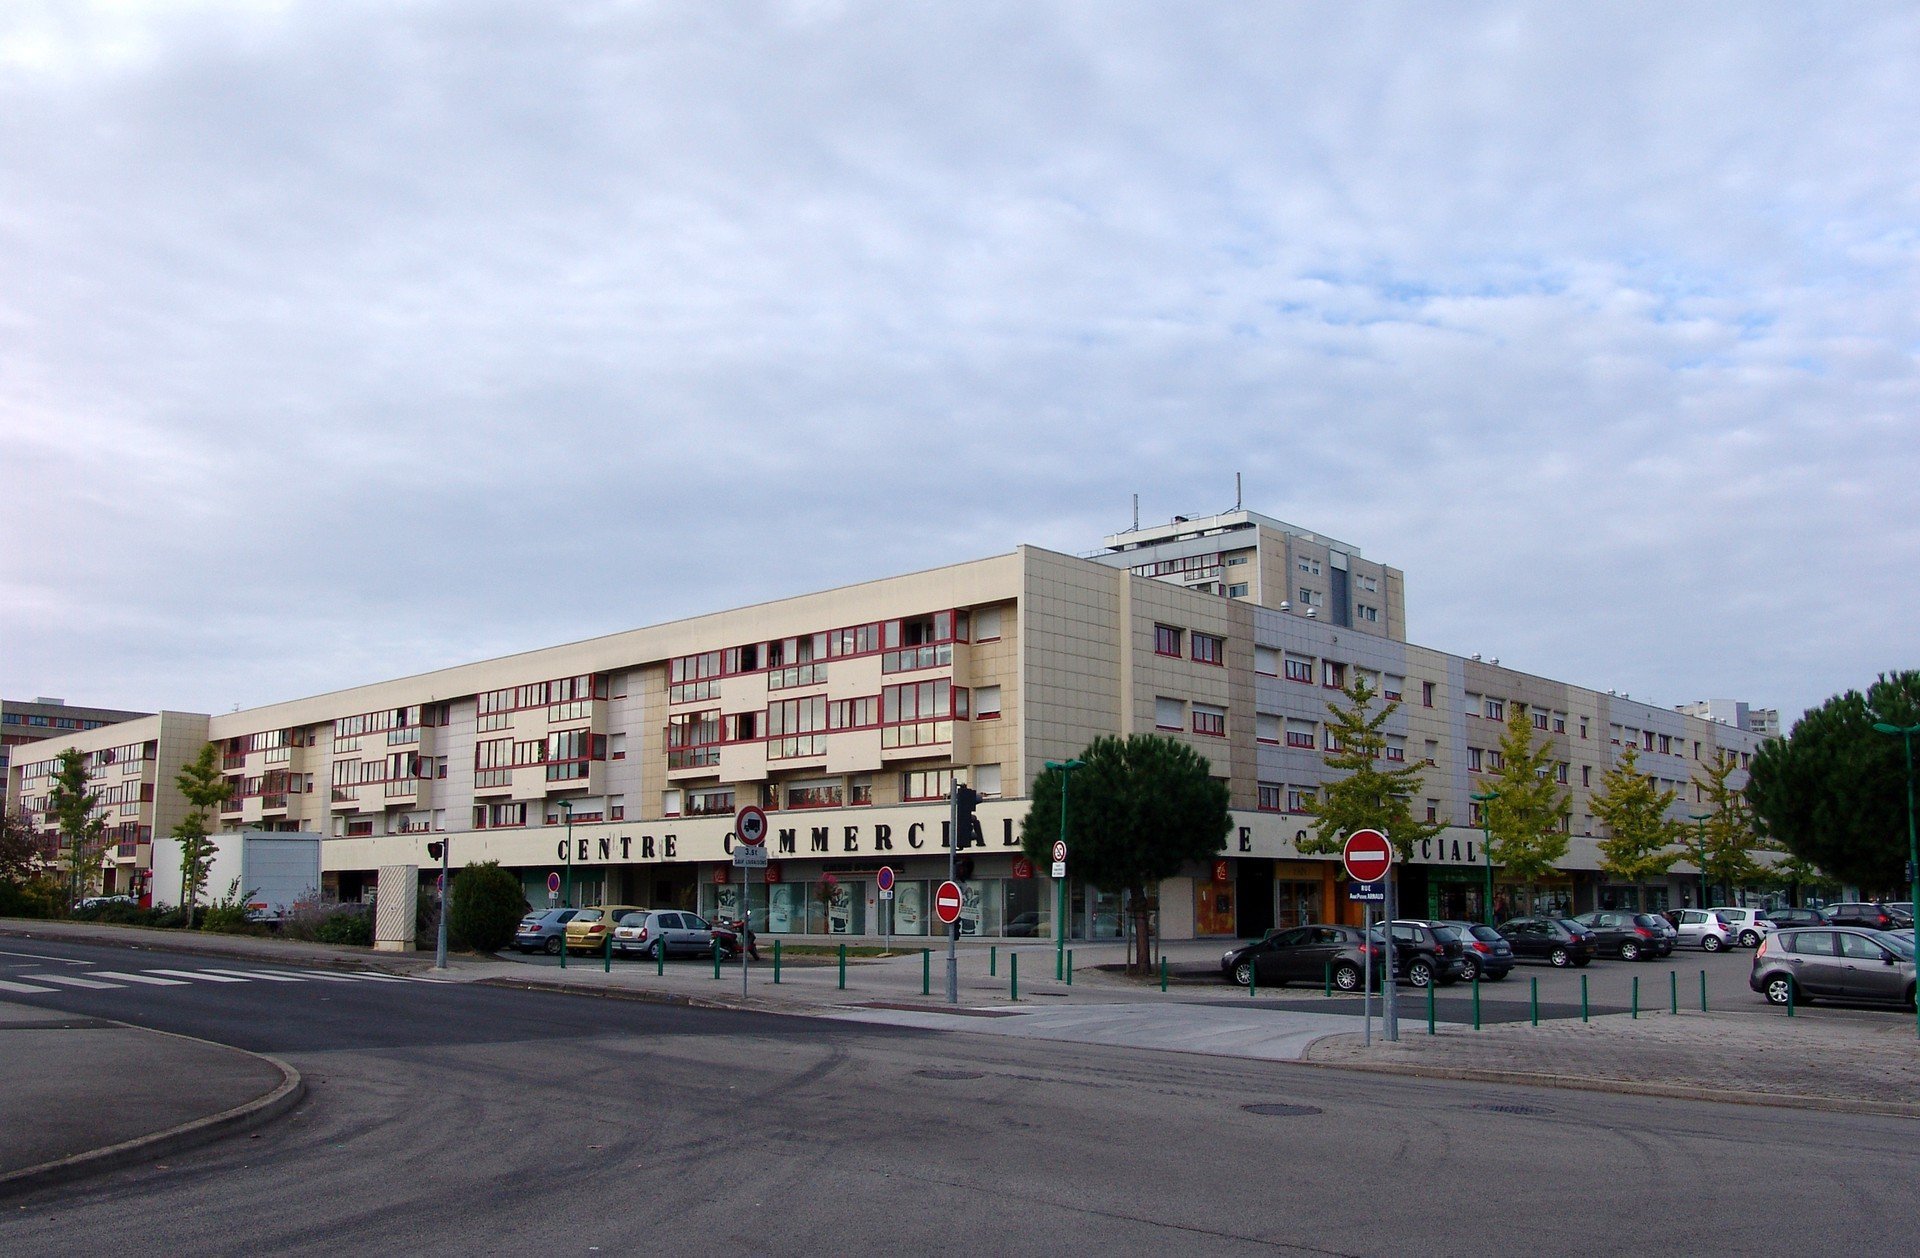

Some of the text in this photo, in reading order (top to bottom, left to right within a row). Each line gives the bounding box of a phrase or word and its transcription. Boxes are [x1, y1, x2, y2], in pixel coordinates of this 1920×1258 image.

[557, 818, 1020, 861] CENTRE CMMERCIAL
[1360, 884, 1371, 892] RUE
